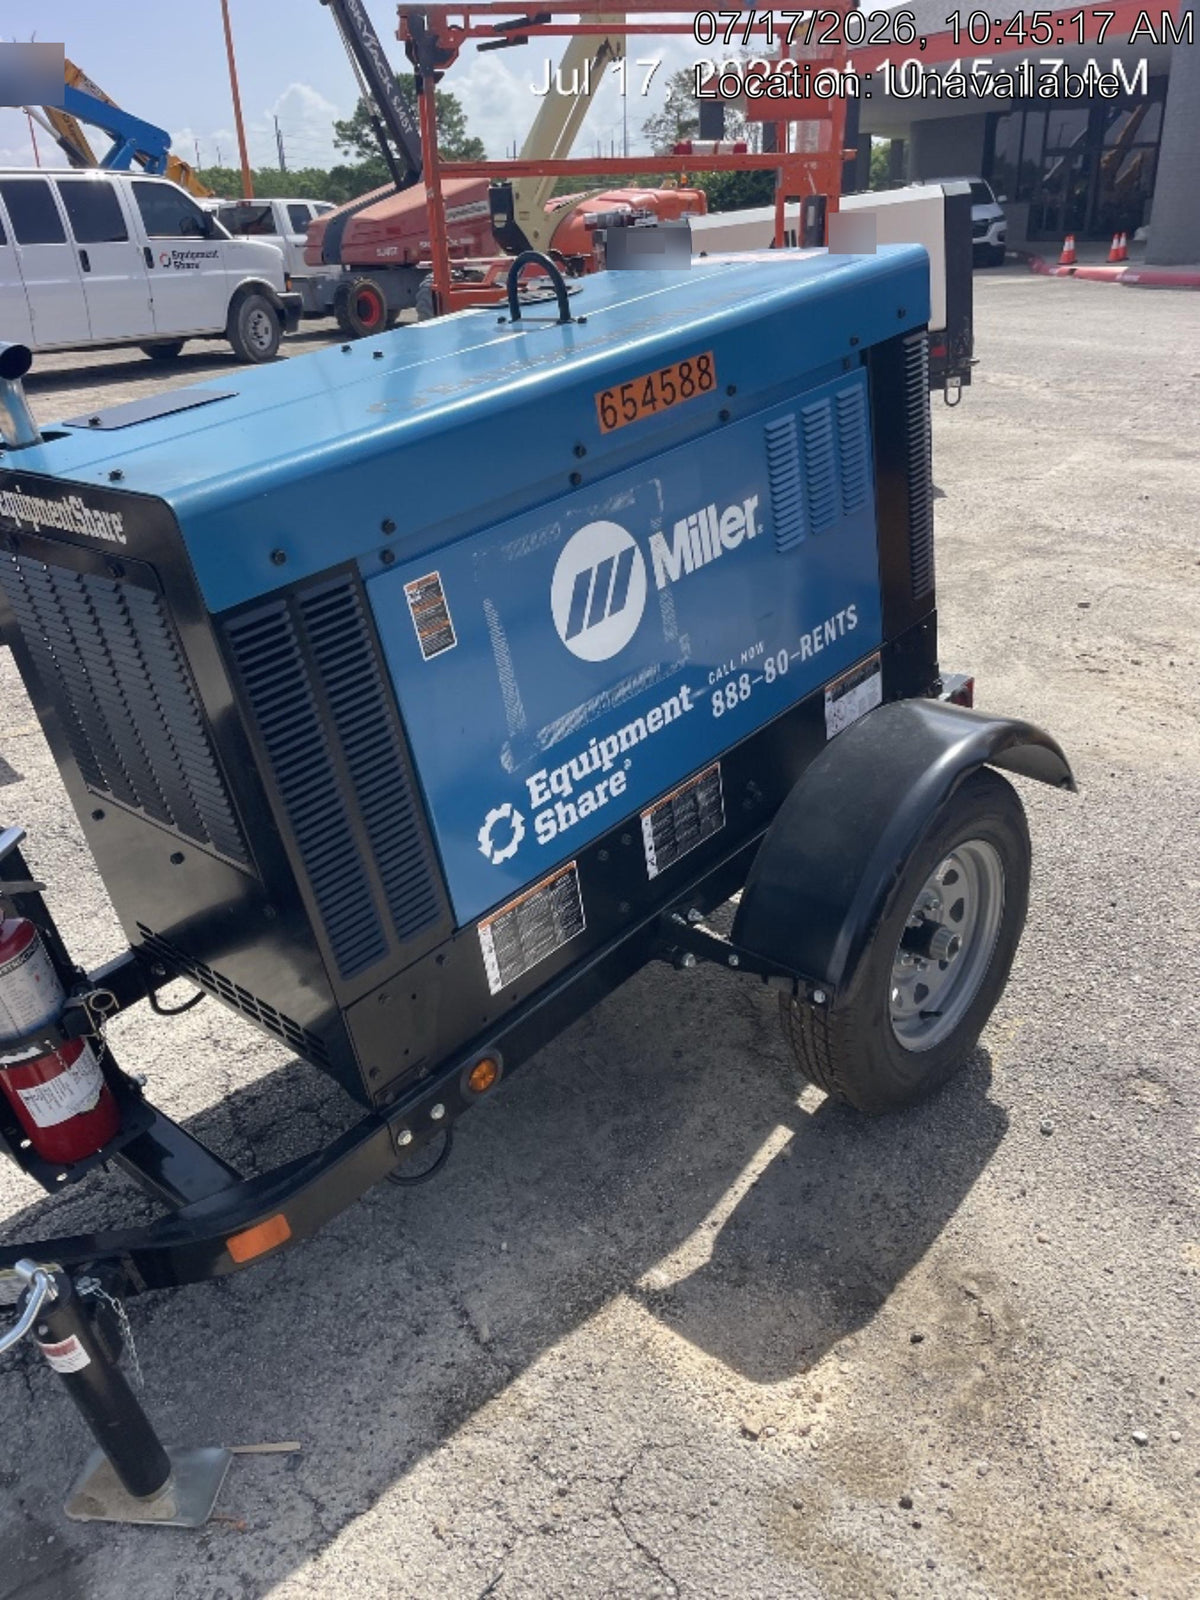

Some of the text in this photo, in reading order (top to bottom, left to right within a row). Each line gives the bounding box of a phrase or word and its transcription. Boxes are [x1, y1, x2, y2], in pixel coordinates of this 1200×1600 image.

[599, 354, 713, 430] 654588
[648, 494, 760, 591] Miller
[708, 640, 766, 686] CALL NOW
[711, 603, 858, 718] 888-80-RENTS
[525, 684, 695, 809] Equipment
[533, 767, 628, 846] Share
